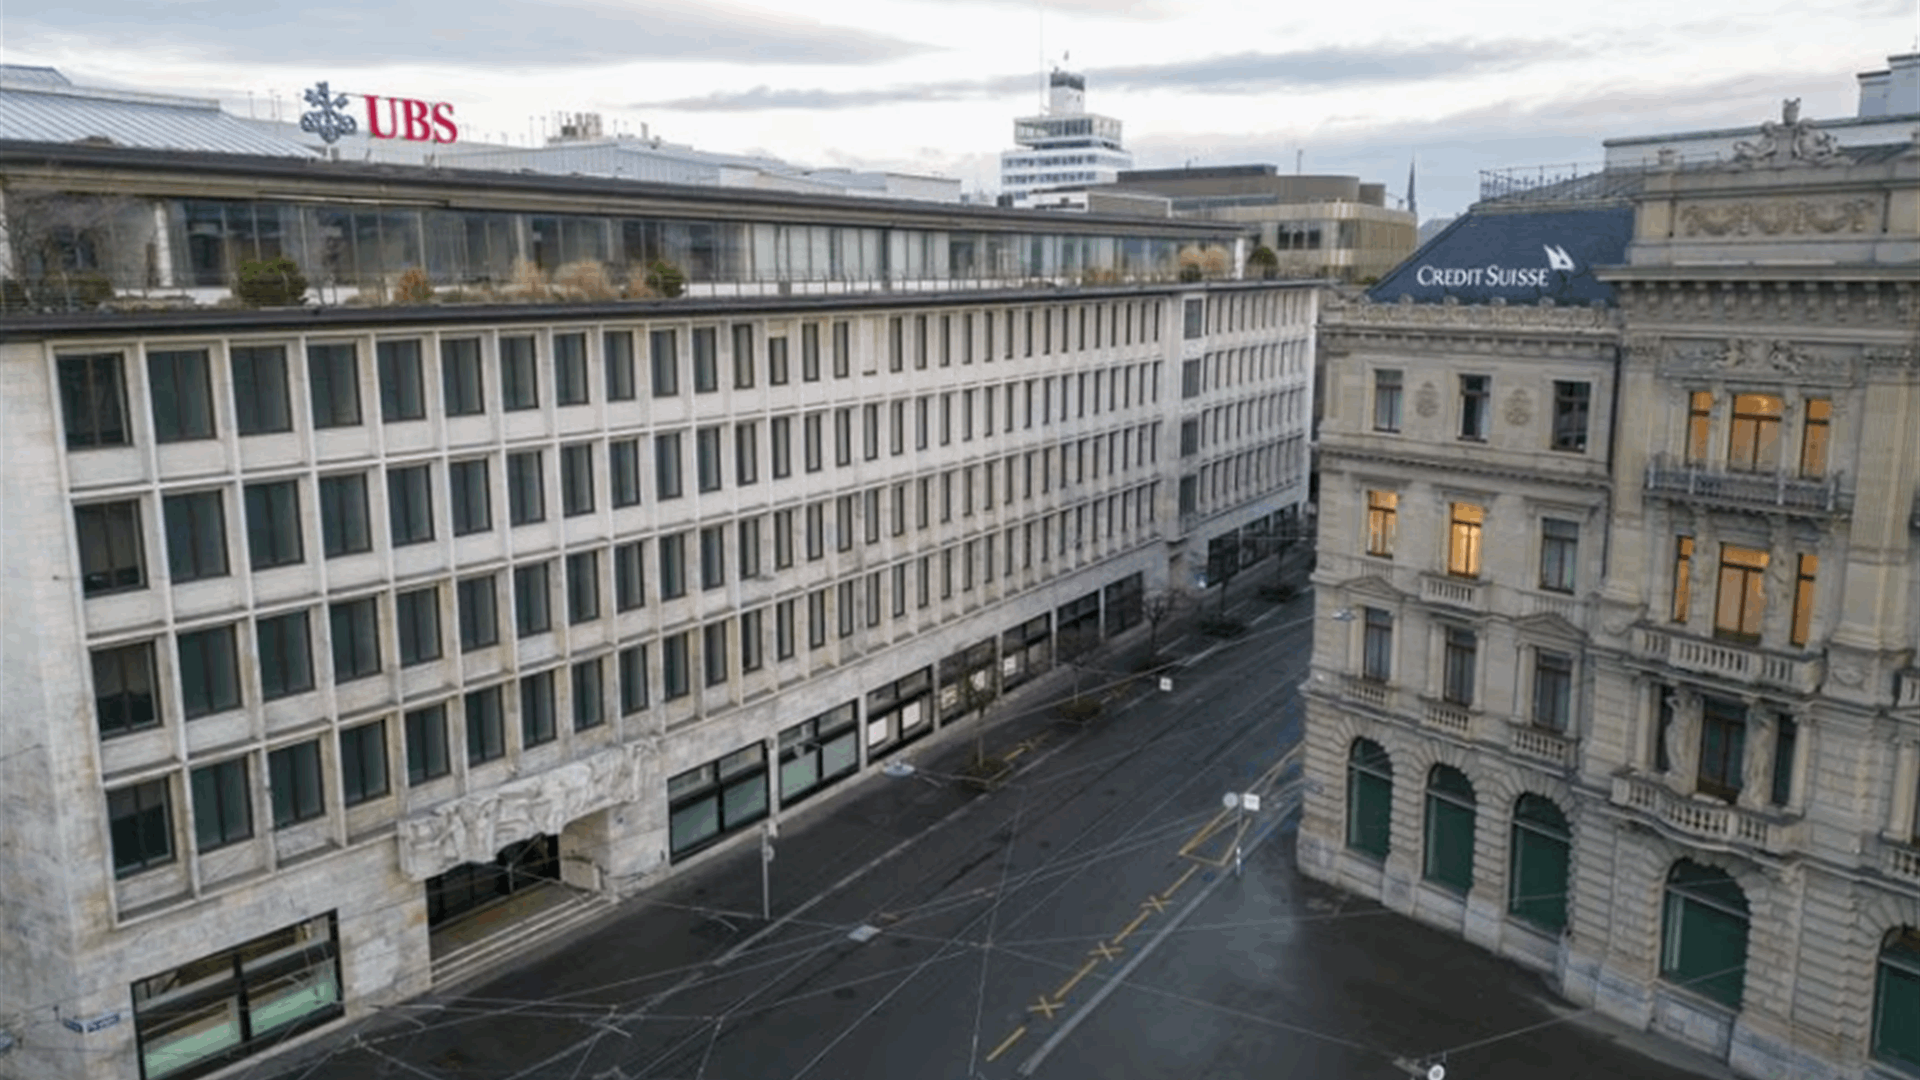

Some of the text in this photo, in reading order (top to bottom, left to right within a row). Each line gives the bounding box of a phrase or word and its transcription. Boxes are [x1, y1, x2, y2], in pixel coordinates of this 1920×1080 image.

[363, 94, 458, 144] UBS
[1417, 264, 1549, 287] CREDIT SUISSE
